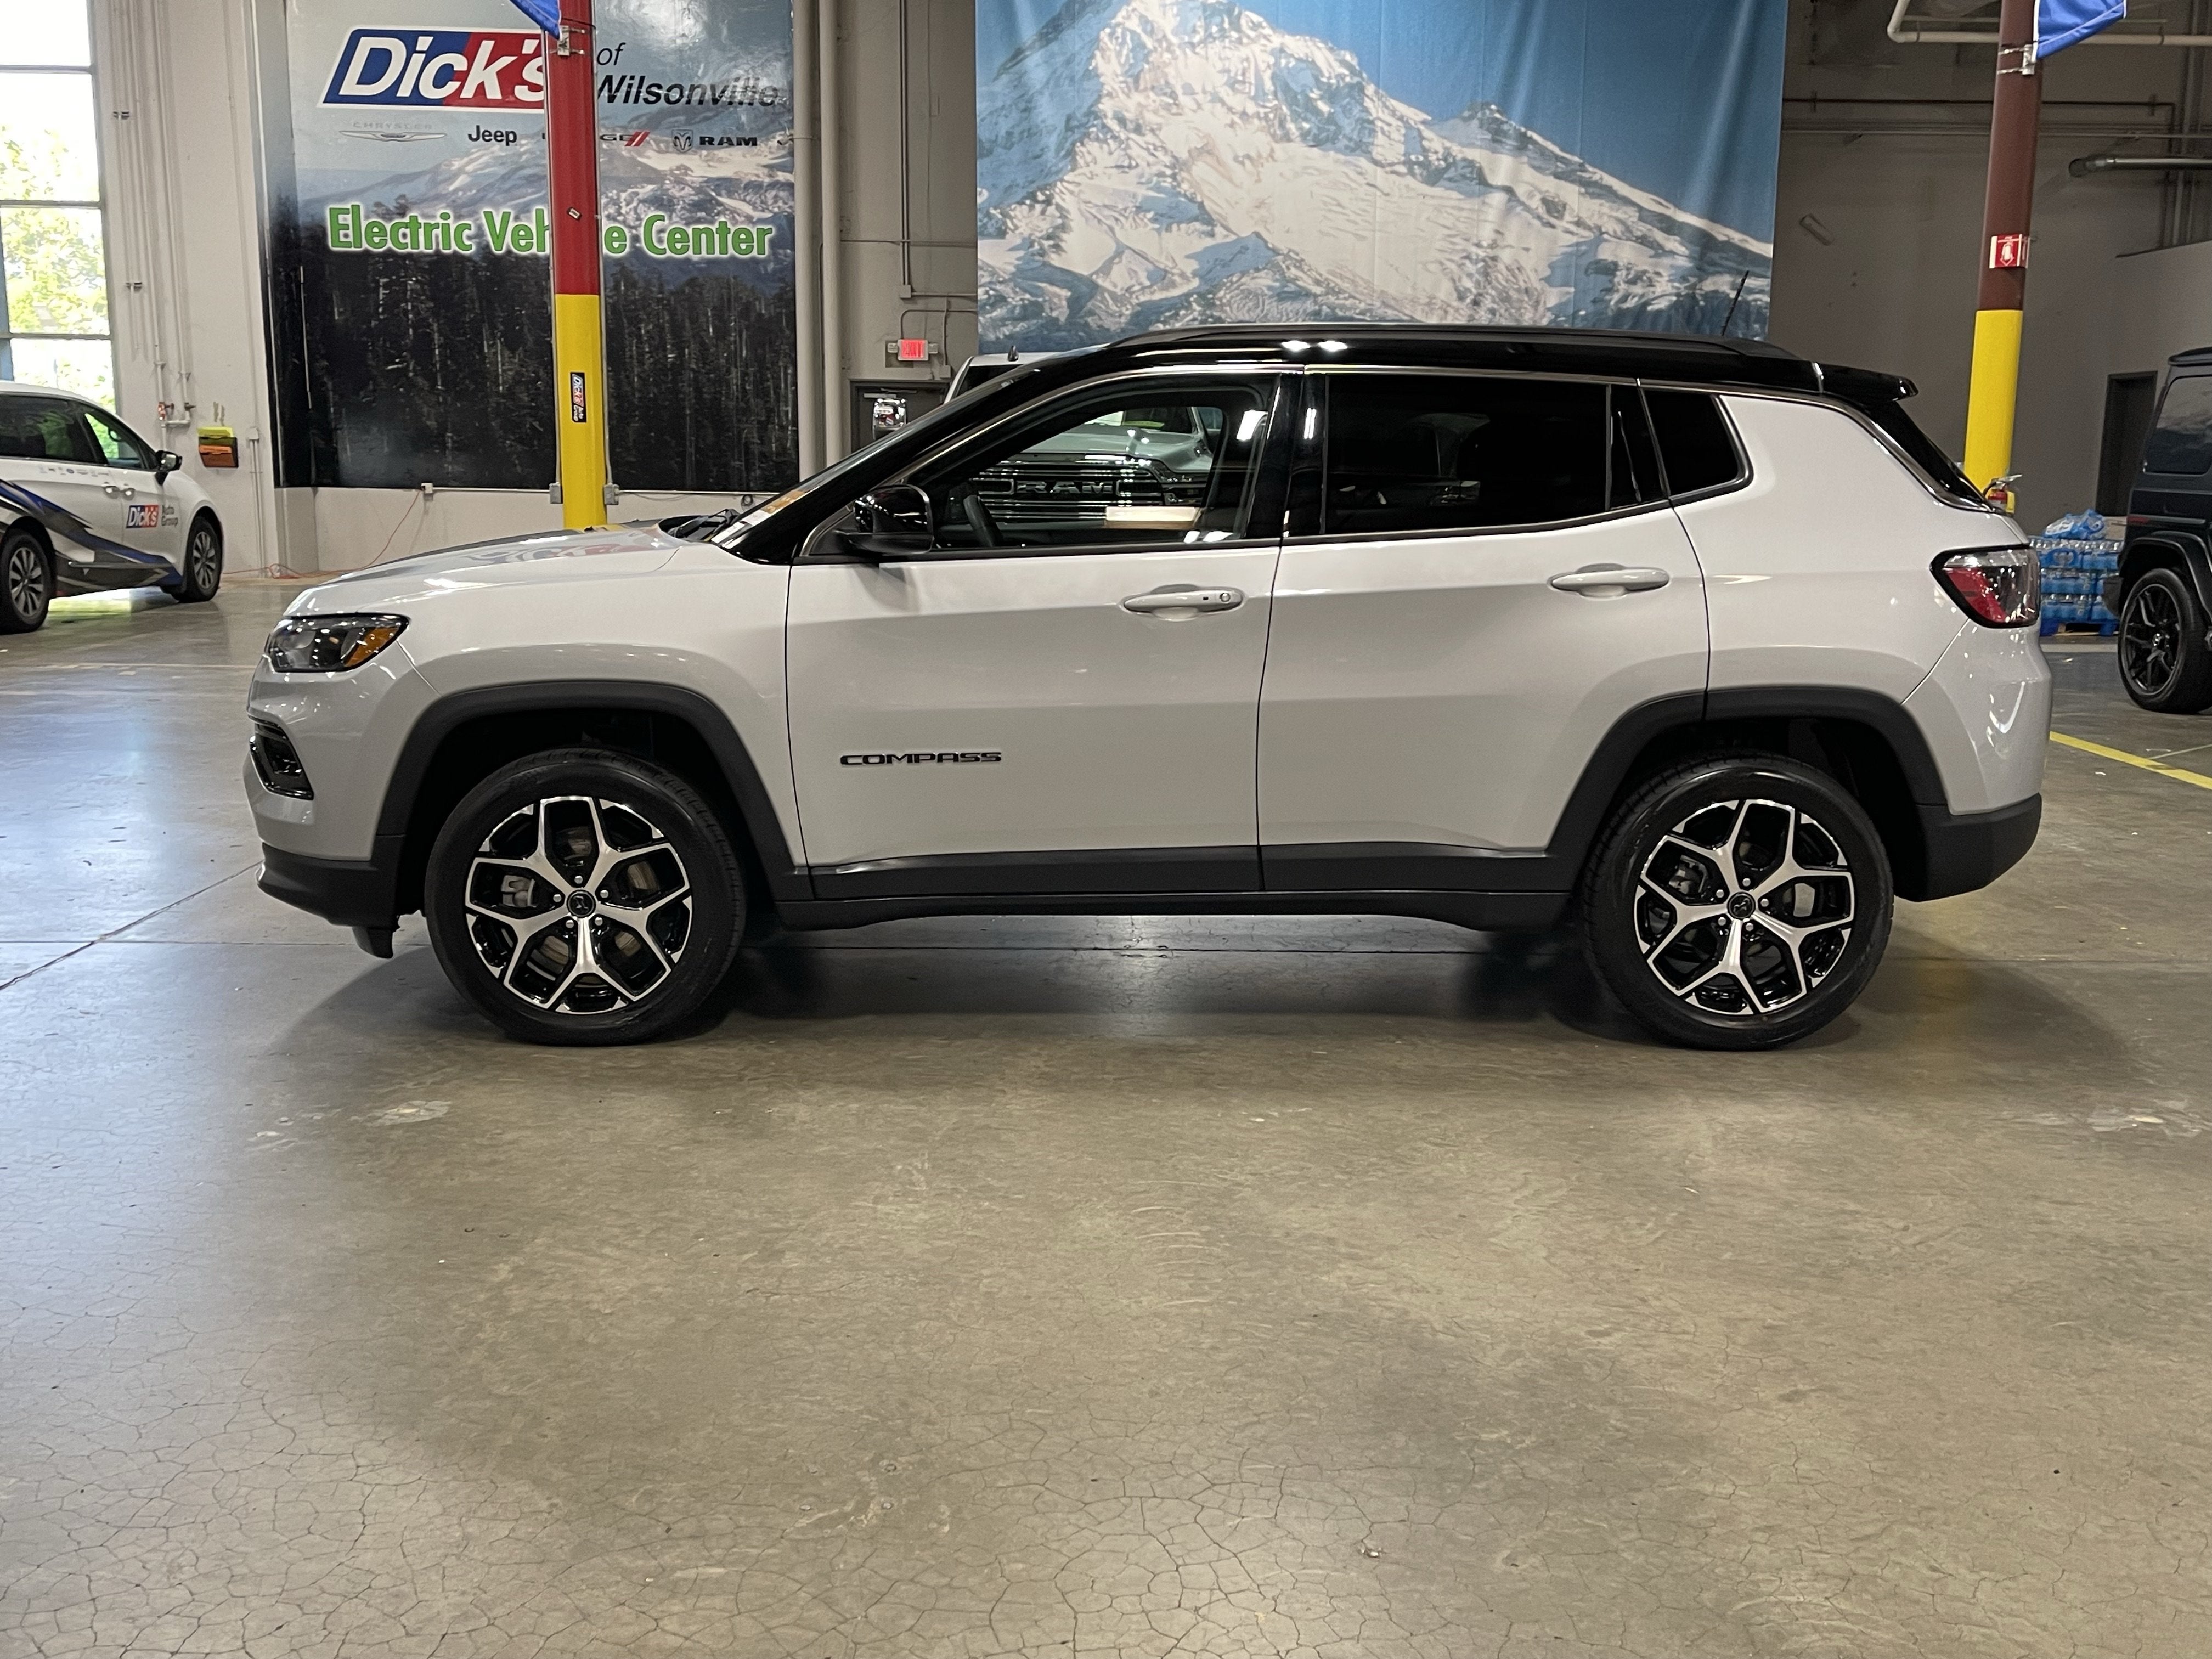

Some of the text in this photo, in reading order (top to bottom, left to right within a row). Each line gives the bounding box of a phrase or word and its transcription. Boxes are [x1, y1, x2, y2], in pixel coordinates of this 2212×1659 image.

[596, 42, 626, 66] of
[338, 36, 544, 101] Dick's
[468, 125, 517, 146] Jeep
[699, 136, 758, 146] RAM
[329, 205, 773, 255] Electric Vehe Center
[1017, 480, 1114, 494] RAM
[127, 506, 157, 526] Dick's
[840, 752, 1002, 765] COMPASS
